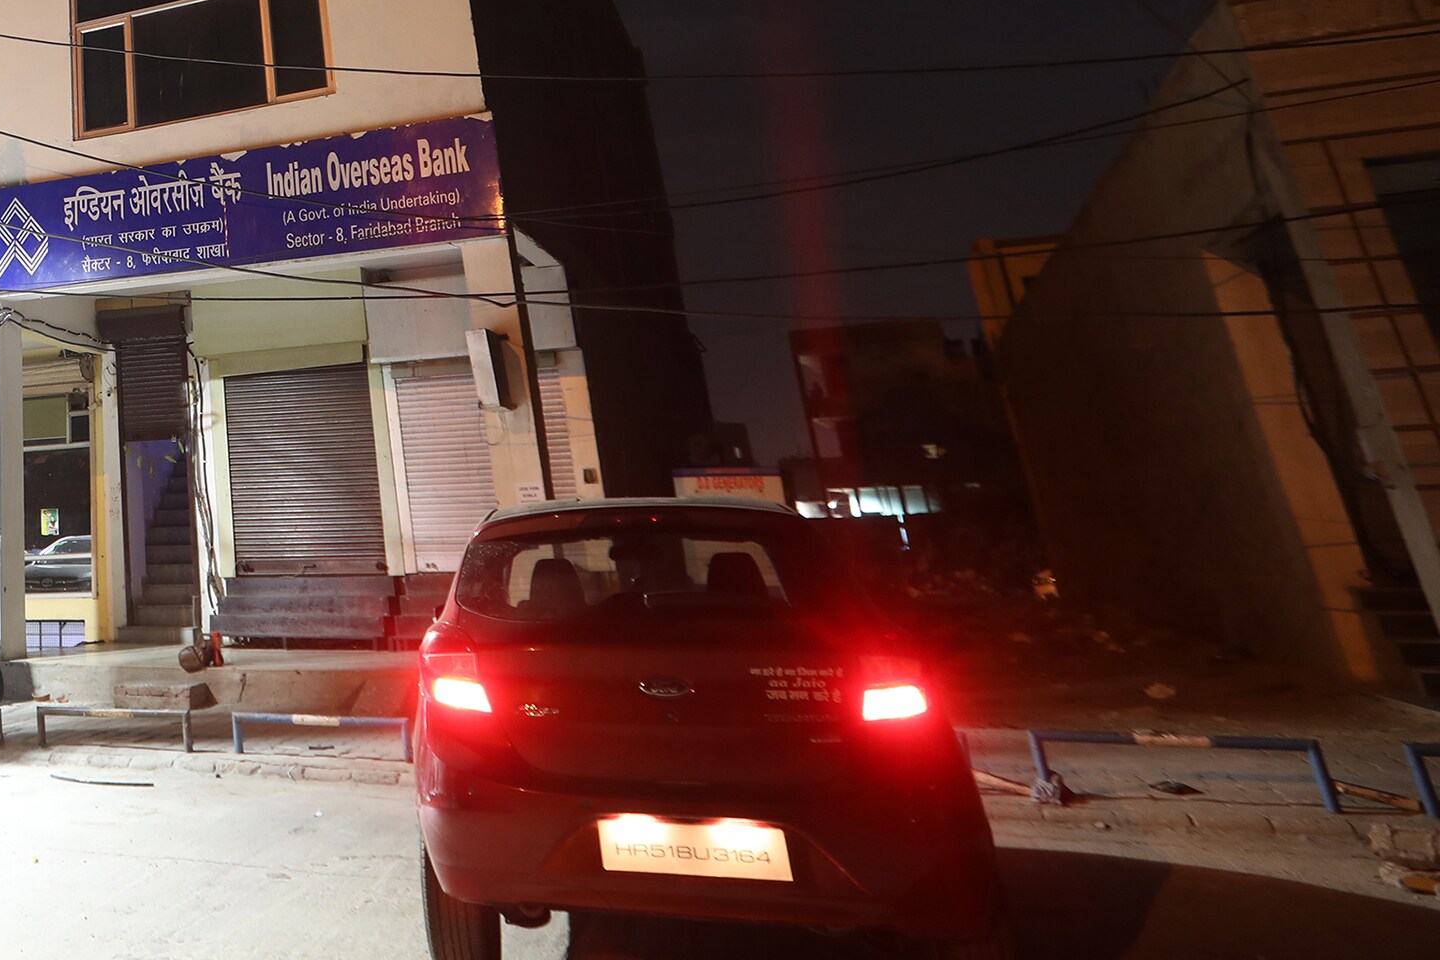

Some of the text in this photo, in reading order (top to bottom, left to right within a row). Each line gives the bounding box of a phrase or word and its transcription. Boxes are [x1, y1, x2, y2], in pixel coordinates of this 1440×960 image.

[266, 138, 470, 199] Indian Overseas Bank
[63, 186, 125, 231] इण्डियन
[209, 161, 242, 206] बैंक
[282, 188, 460, 226] (A Govt. of India Undertaking)
[118, 228, 155, 244] सरकार
[162, 225, 176, 238] का
[182, 218, 224, 236] उपक्रम)
[286, 229, 325, 249] Sector
[350, 219, 412, 240] Faridabad
[415, 212, 461, 234] Branch
[81, 255, 111, 273] सैक्टर
[196, 242, 226, 259] शाखा
